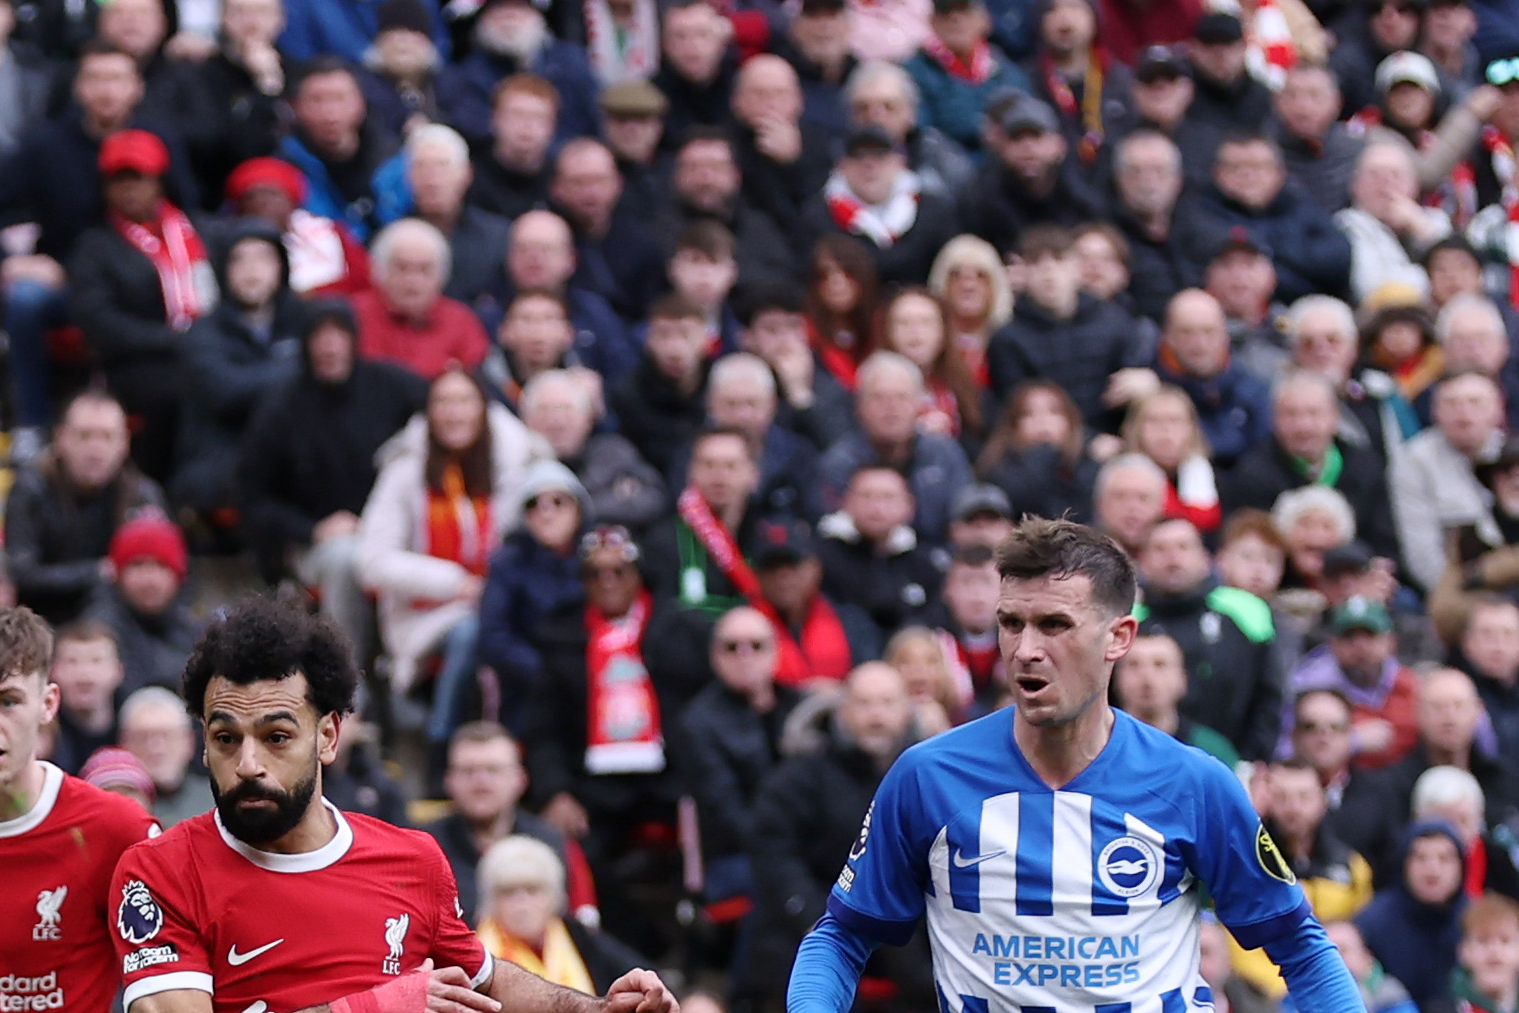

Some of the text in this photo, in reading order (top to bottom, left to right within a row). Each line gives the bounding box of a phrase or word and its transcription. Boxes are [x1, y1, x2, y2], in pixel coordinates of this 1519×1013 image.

[32, 927, 62, 941] LFC
[972, 932, 1140, 960] AMERICAN
[382, 959, 401, 976] LFC
[994, 961, 1141, 988] EXPRESS
